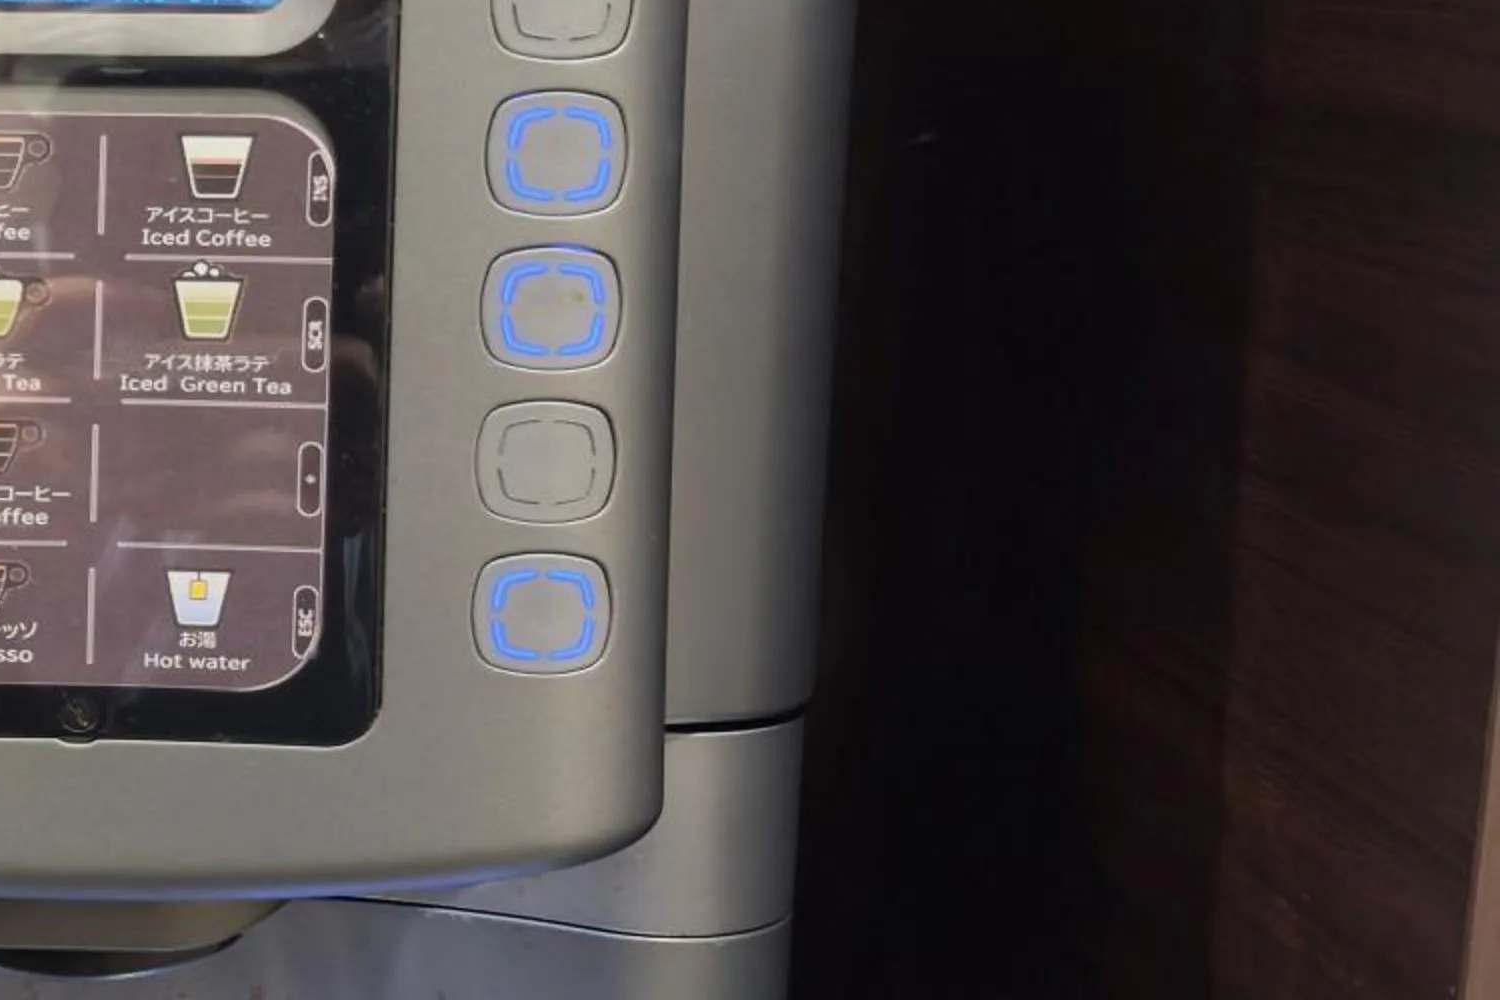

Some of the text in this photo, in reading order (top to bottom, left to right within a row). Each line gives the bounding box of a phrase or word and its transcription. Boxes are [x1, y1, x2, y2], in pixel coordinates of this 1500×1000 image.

[313, 174, 328, 202] INS
[146, 206, 270, 225] アイスコーヒー
[141, 229, 272, 248] Iced Coffee
[144, 353, 270, 373] アイス抹茶ラテ
[2, 374, 42, 392] Tea
[120, 374, 292, 396] Iced Green Tea
[299, 608, 314, 637] ESC
[178, 631, 217, 650] お湯
[144, 653, 252, 672] Hot water
